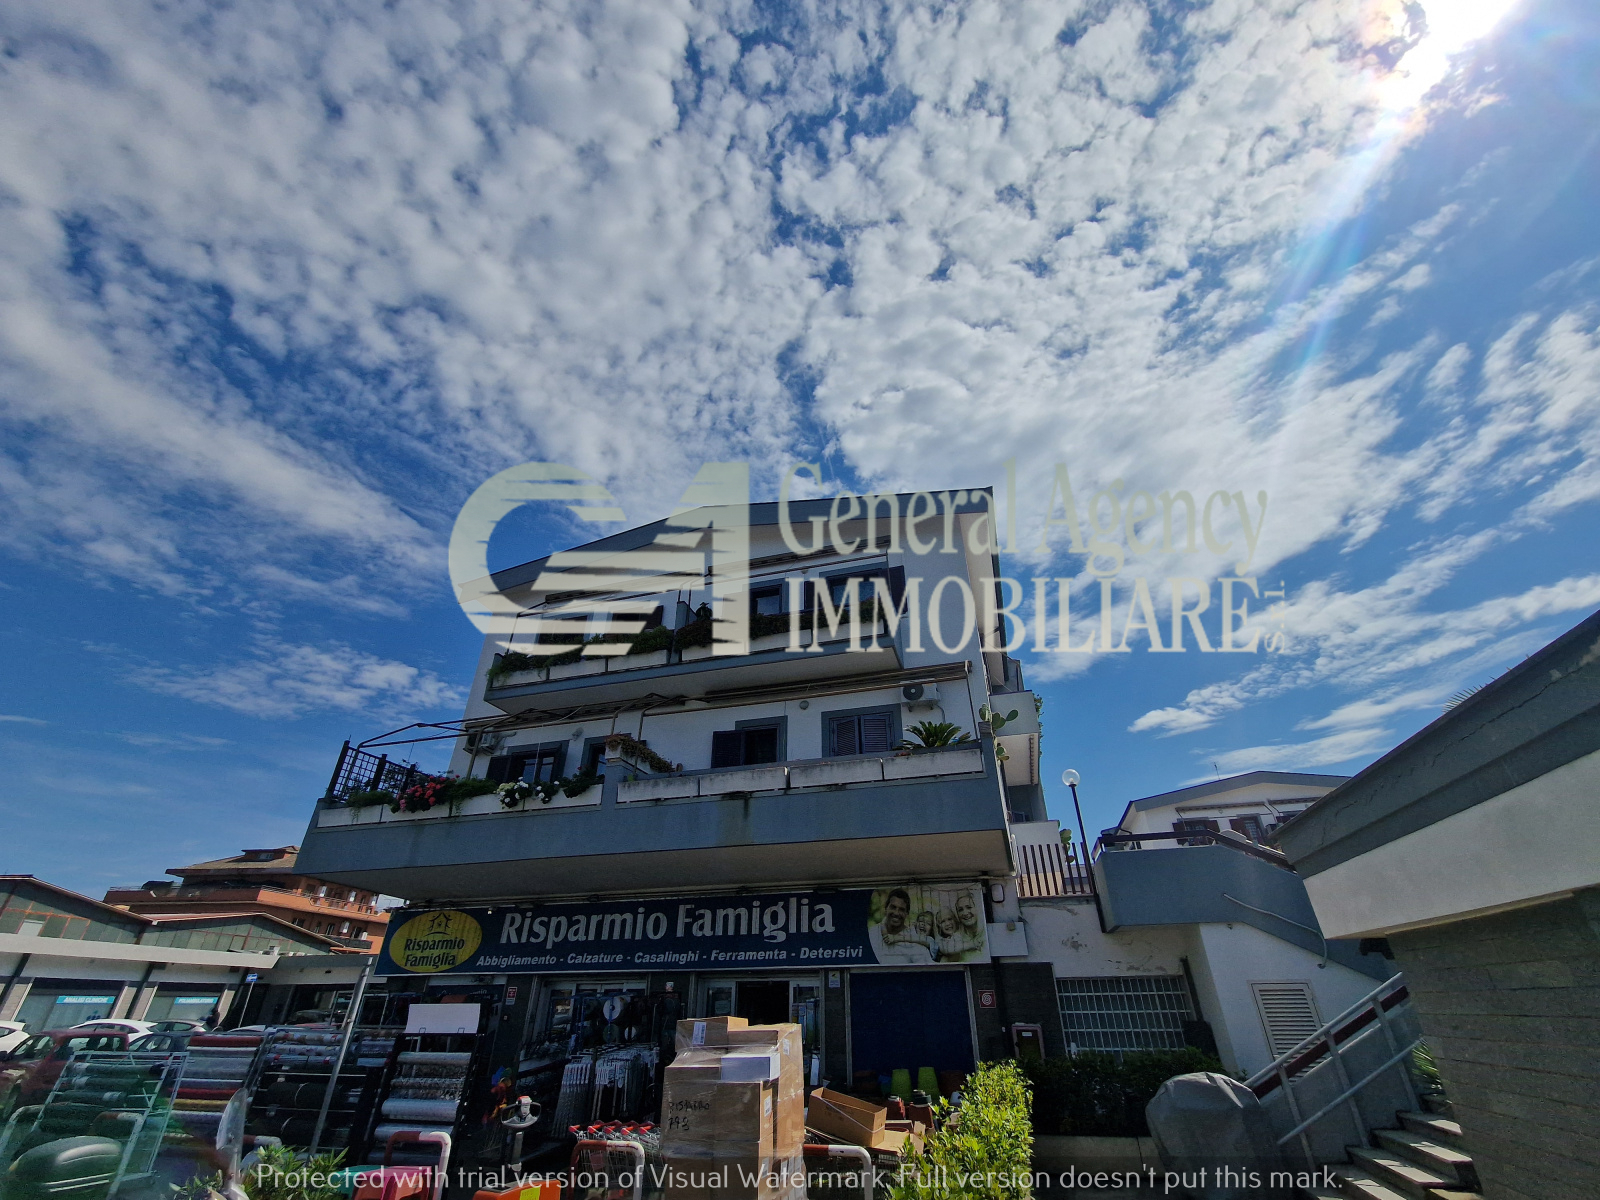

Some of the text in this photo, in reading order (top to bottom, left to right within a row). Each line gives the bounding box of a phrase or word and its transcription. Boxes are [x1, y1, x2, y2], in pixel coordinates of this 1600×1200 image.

[500, 897, 836, 949] Risparmio Famiglia
[404, 937, 465, 952] Risparmio
[404, 953, 457, 969] Famiglia
[476, 946, 863, 968] Abbigliamento Calzature Casalinghi Ferramenta Detersivi
